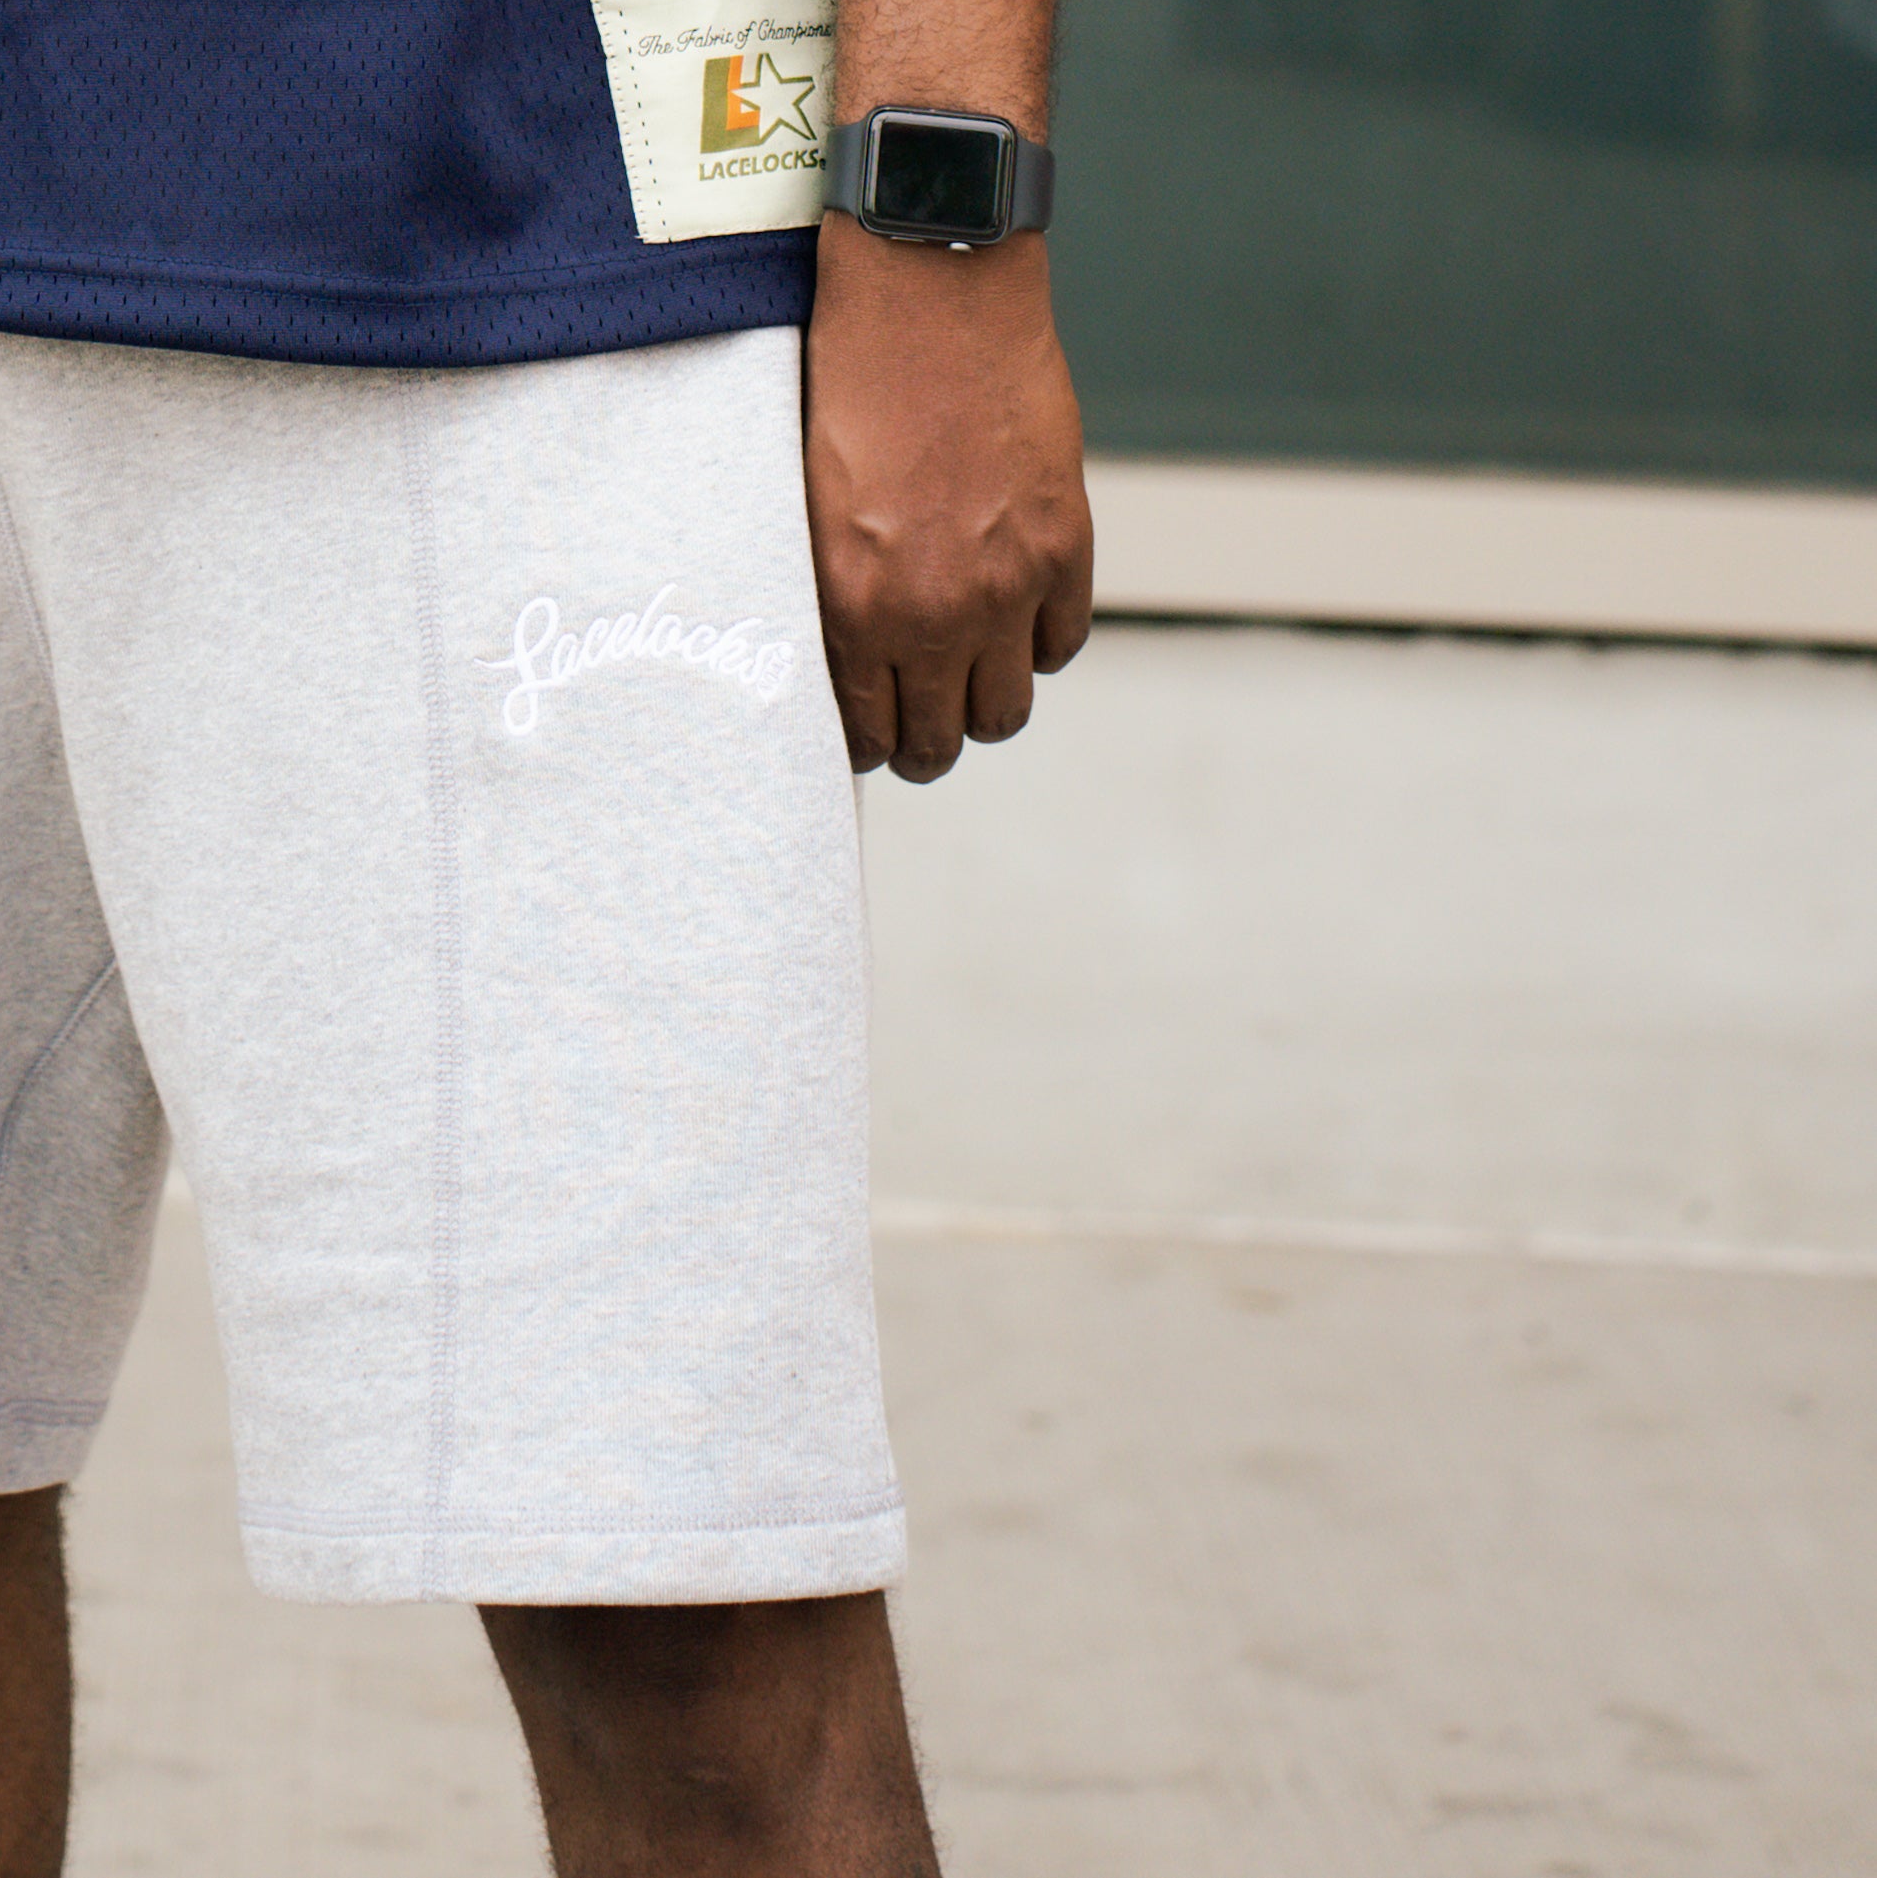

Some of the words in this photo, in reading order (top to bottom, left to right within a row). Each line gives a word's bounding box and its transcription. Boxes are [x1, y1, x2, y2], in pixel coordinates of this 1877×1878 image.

[637, 34, 674, 57] The
[677, 26, 734, 52] Fabric
[734, 21, 758, 49] of
[698, 148, 819, 182] LACELOCKS
[473, 582, 794, 737] Lacelocks
